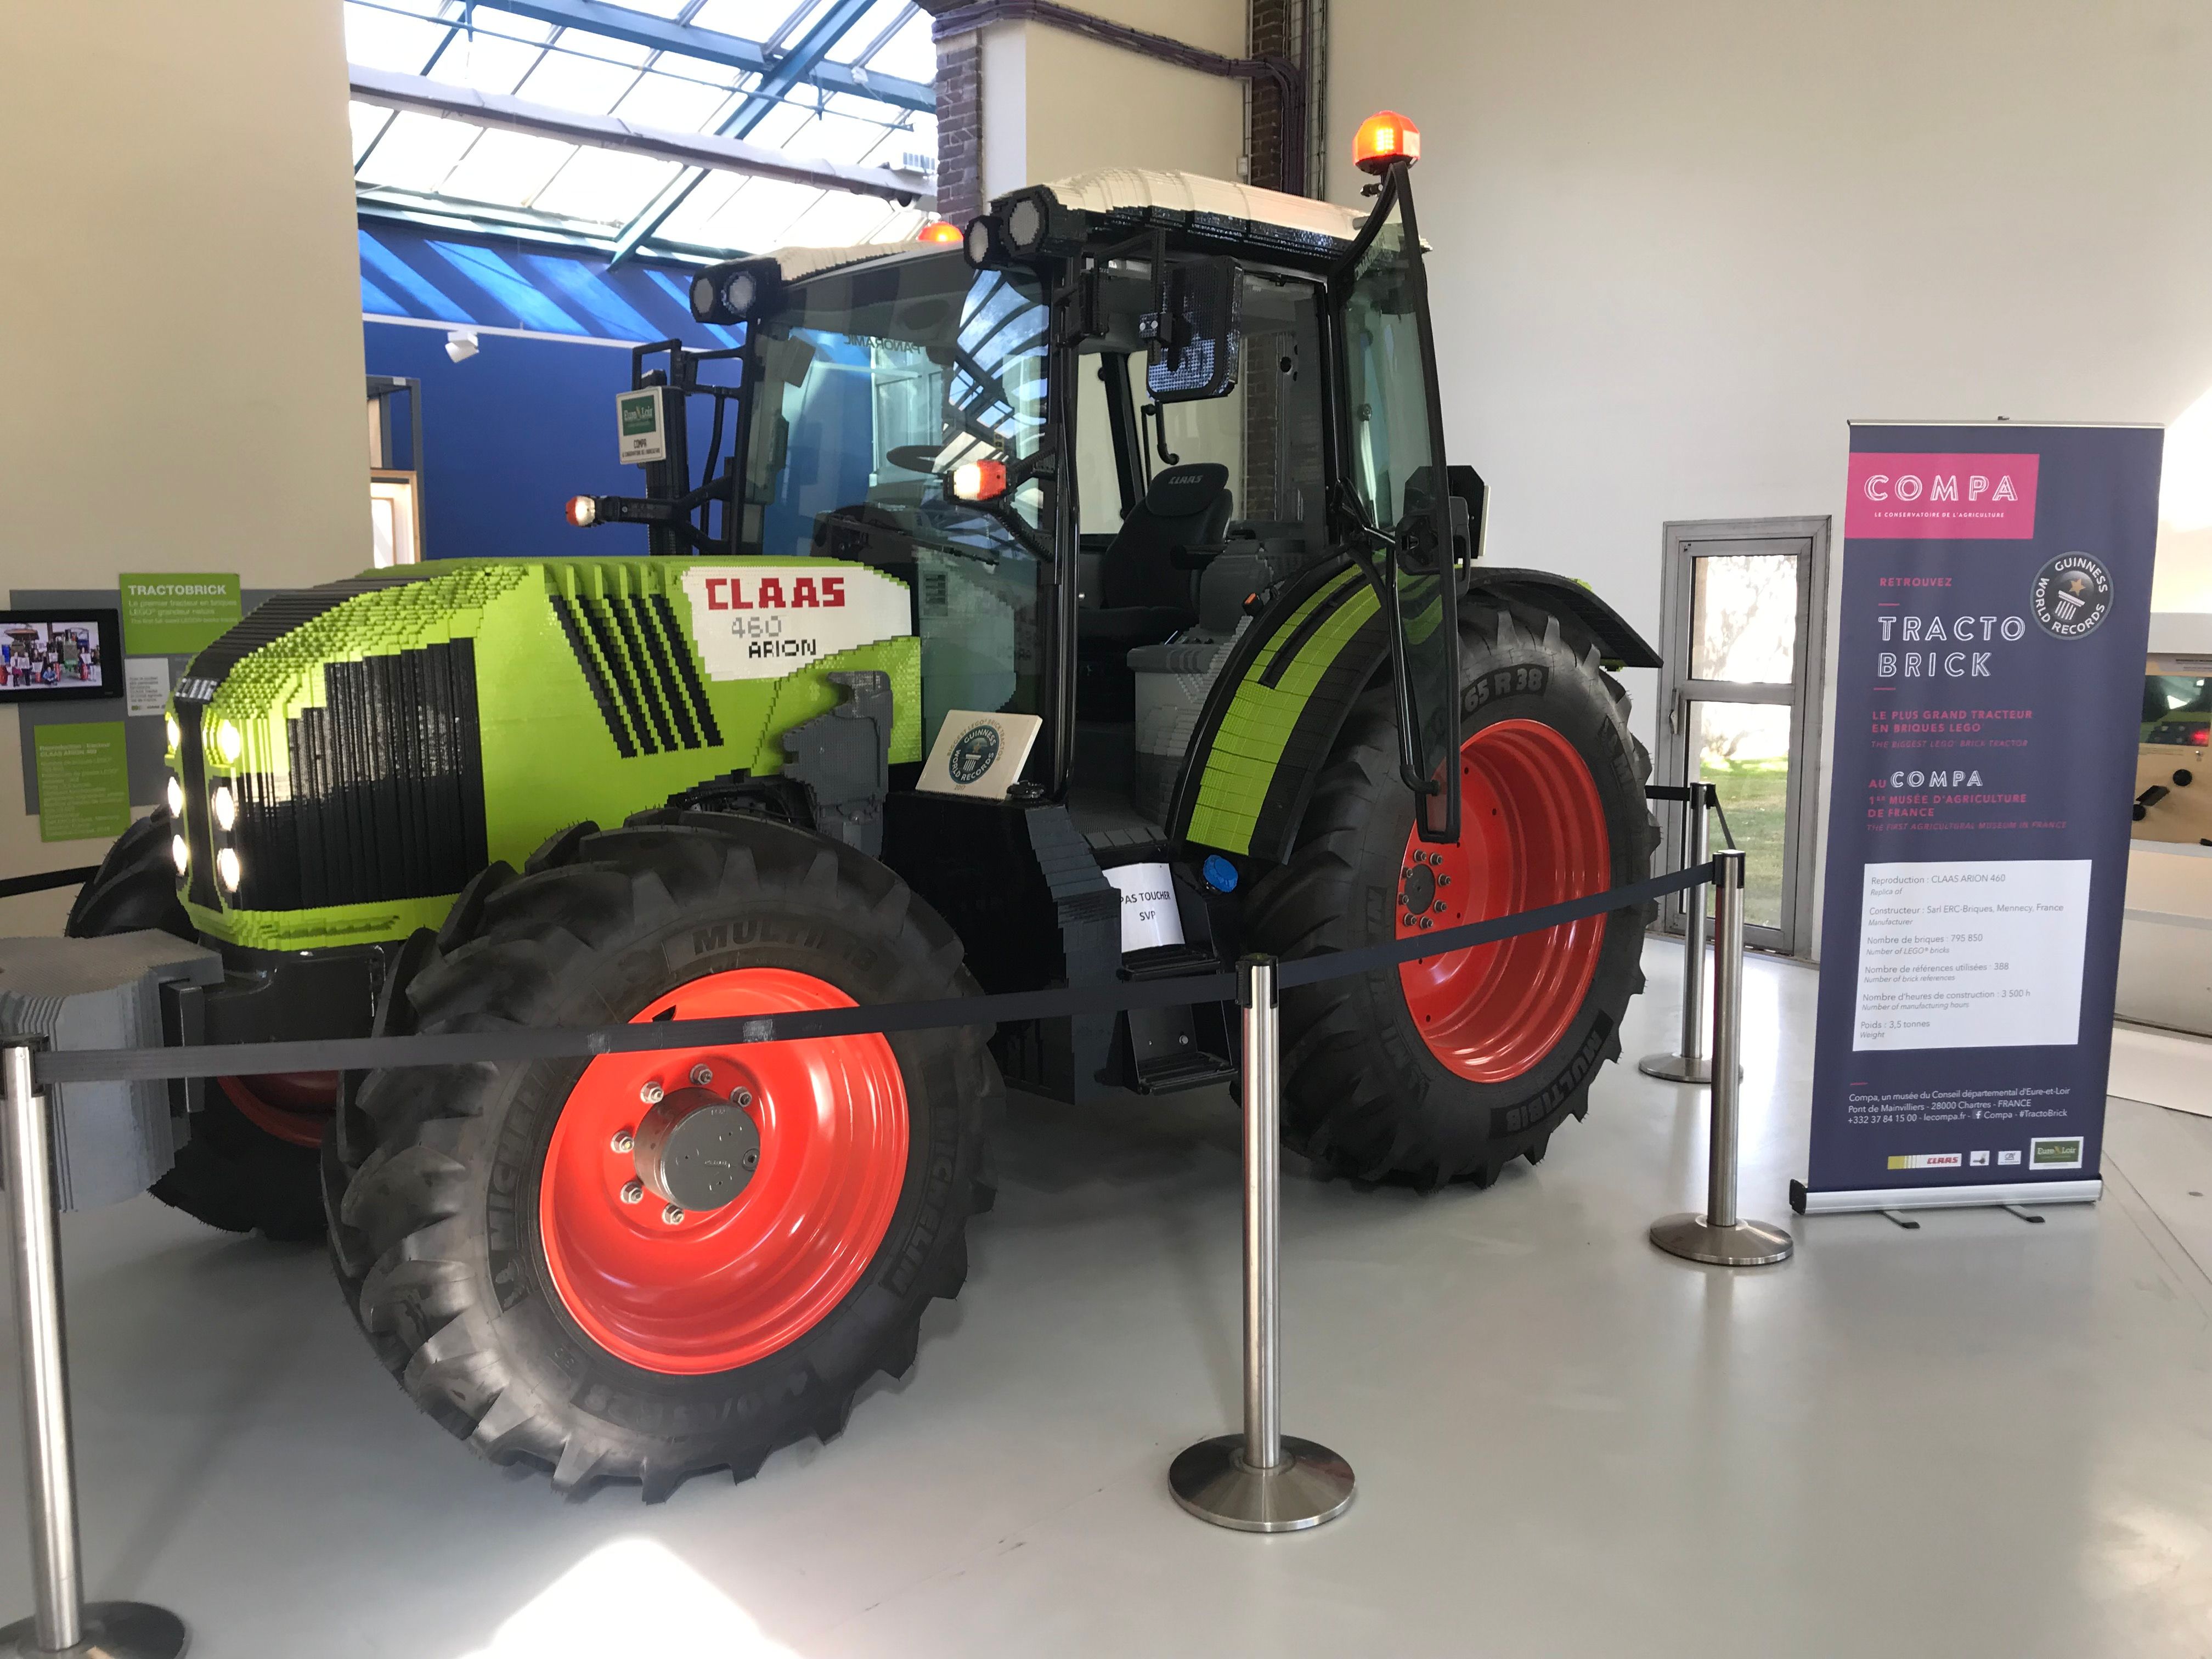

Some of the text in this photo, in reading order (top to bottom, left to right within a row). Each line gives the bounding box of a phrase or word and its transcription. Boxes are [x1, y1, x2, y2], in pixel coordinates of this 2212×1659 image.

[634, 439, 647, 448] COMPA
[1168, 474, 1204, 484] CLAAS
[1864, 474, 2018, 501] COMPA
[1880, 578, 1952, 586] RETROUVEZ
[2055, 558, 2108, 594] GUINNESS
[128, 585, 226, 595] TRACTOBRICK
[706, 577, 845, 610] CLAAS
[2035, 578, 2106, 635] WORLD RECORDS
[732, 615, 782, 637] 460
[1878, 616, 2026, 641] TRACTO
[749, 639, 816, 658] ARION
[1878, 652, 1991, 678] BRICK
[1494, 672, 1511, 695] R
[1515, 668, 1543, 691] 38
[1872, 710, 2032, 720] LE PLUS GRAND TRACTEUR
[1872, 724, 1888, 733] EN
[1894, 724, 1944, 732] BRIQUES
[947, 730, 967, 756] BIGGEST
[988, 719, 1002, 731] BRICK
[964, 729, 996, 746] GUINNESS
[952, 749, 994, 781] WORLD RECORDS
[1869, 770, 1983, 788] AU COMPA
[1889, 793, 1928, 804] MUSÉE
[1933, 794, 2027, 803] D'AGRICULTURE
[1888, 808, 1934, 817] FRANCE
[1871, 876, 1925, 885] Reproduction
[1932, 875, 1959, 883] CLAAS
[1961, 874, 1988, 883] ARION
[1139, 891, 1170, 902] TOUCHER
[1139, 911, 1155, 921] SVP
[1869, 918, 1913, 926] Manufacturer
[1867, 936, 1899, 944] Nombre
[1915, 936, 1944, 945] briques
[1946, 991, 1995, 999] construction
[1889, 1020, 1901, 1029] 3,5
[1506, 1031, 1602, 1132] MULTIBIB
[1849, 1094, 1880, 1103] Compa,
[1893, 1092, 1918, 1100] musée
[1932, 1090, 1960, 1098] Conseil
[1962, 1088, 2017, 1099] départemental
[2019, 1087, 2070, 1096] d'Eure-et-Loir
[1924, 1112, 1966, 1121] lecompa.fr
[1984, 1111, 2012, 1120] Compa
[2019, 1109, 2067, 1117] #TractoBrick
